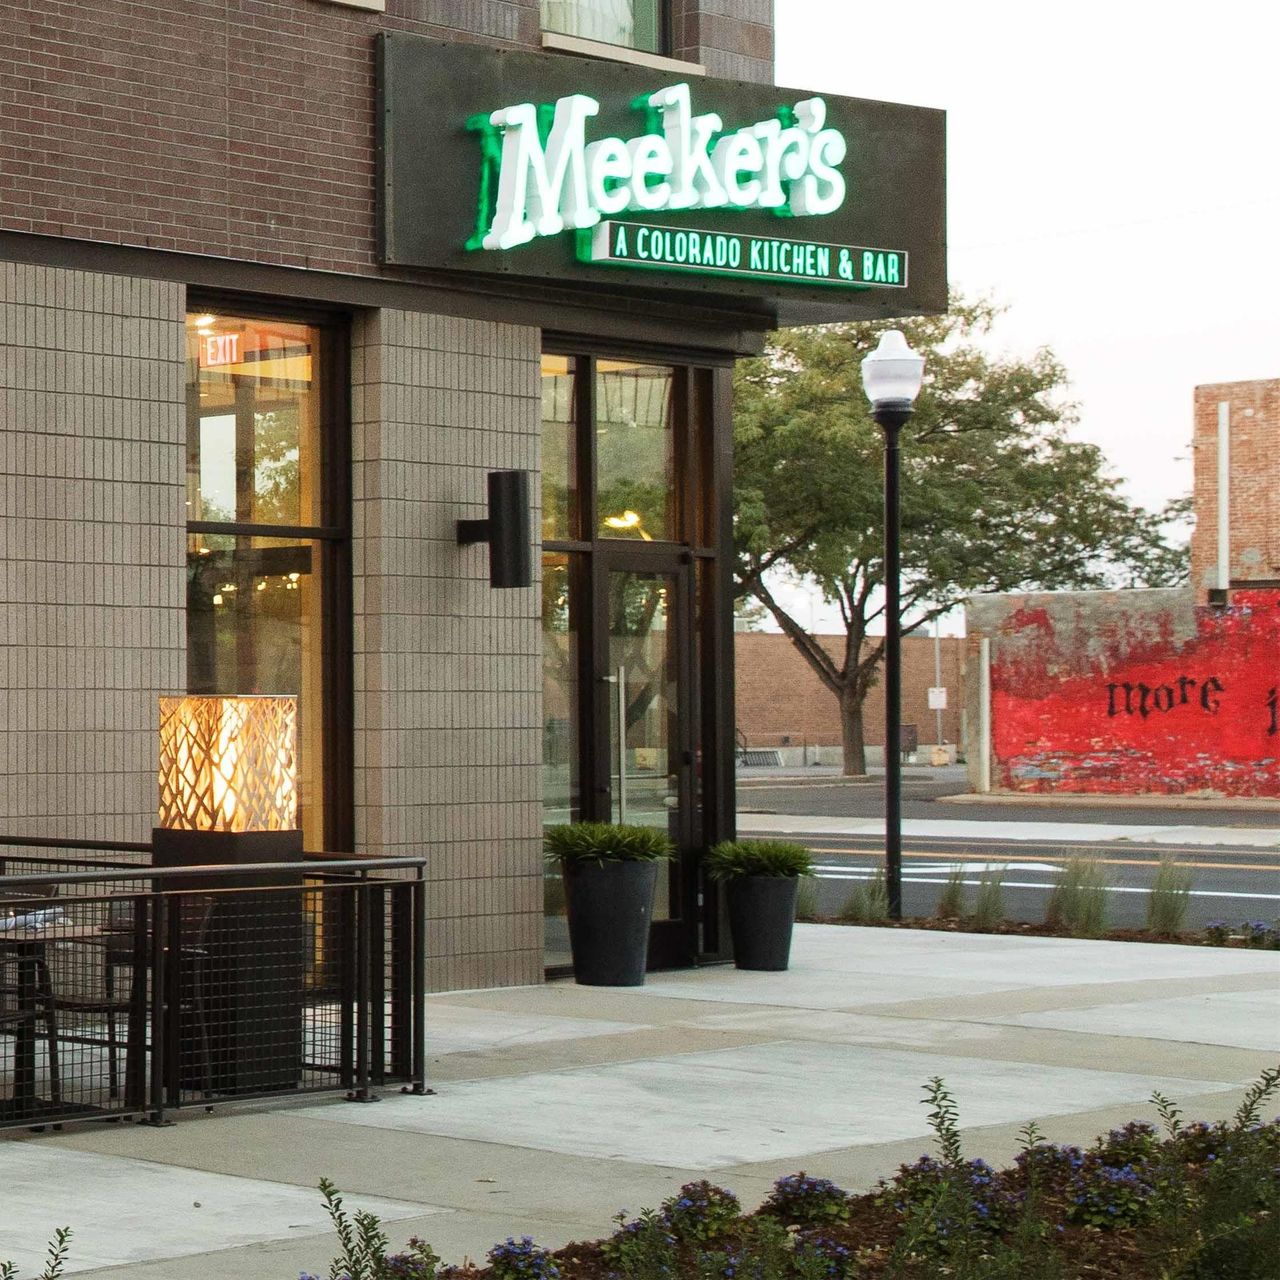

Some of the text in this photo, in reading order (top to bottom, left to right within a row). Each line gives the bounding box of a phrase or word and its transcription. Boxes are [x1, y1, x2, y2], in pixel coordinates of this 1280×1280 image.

[482, 82, 847, 251] Meeker's
[614, 225, 900, 284] A COLORADO KITCHEN & BAR
[206, 333, 239, 366] EXIT
[1106, 674, 1225, 721] more
